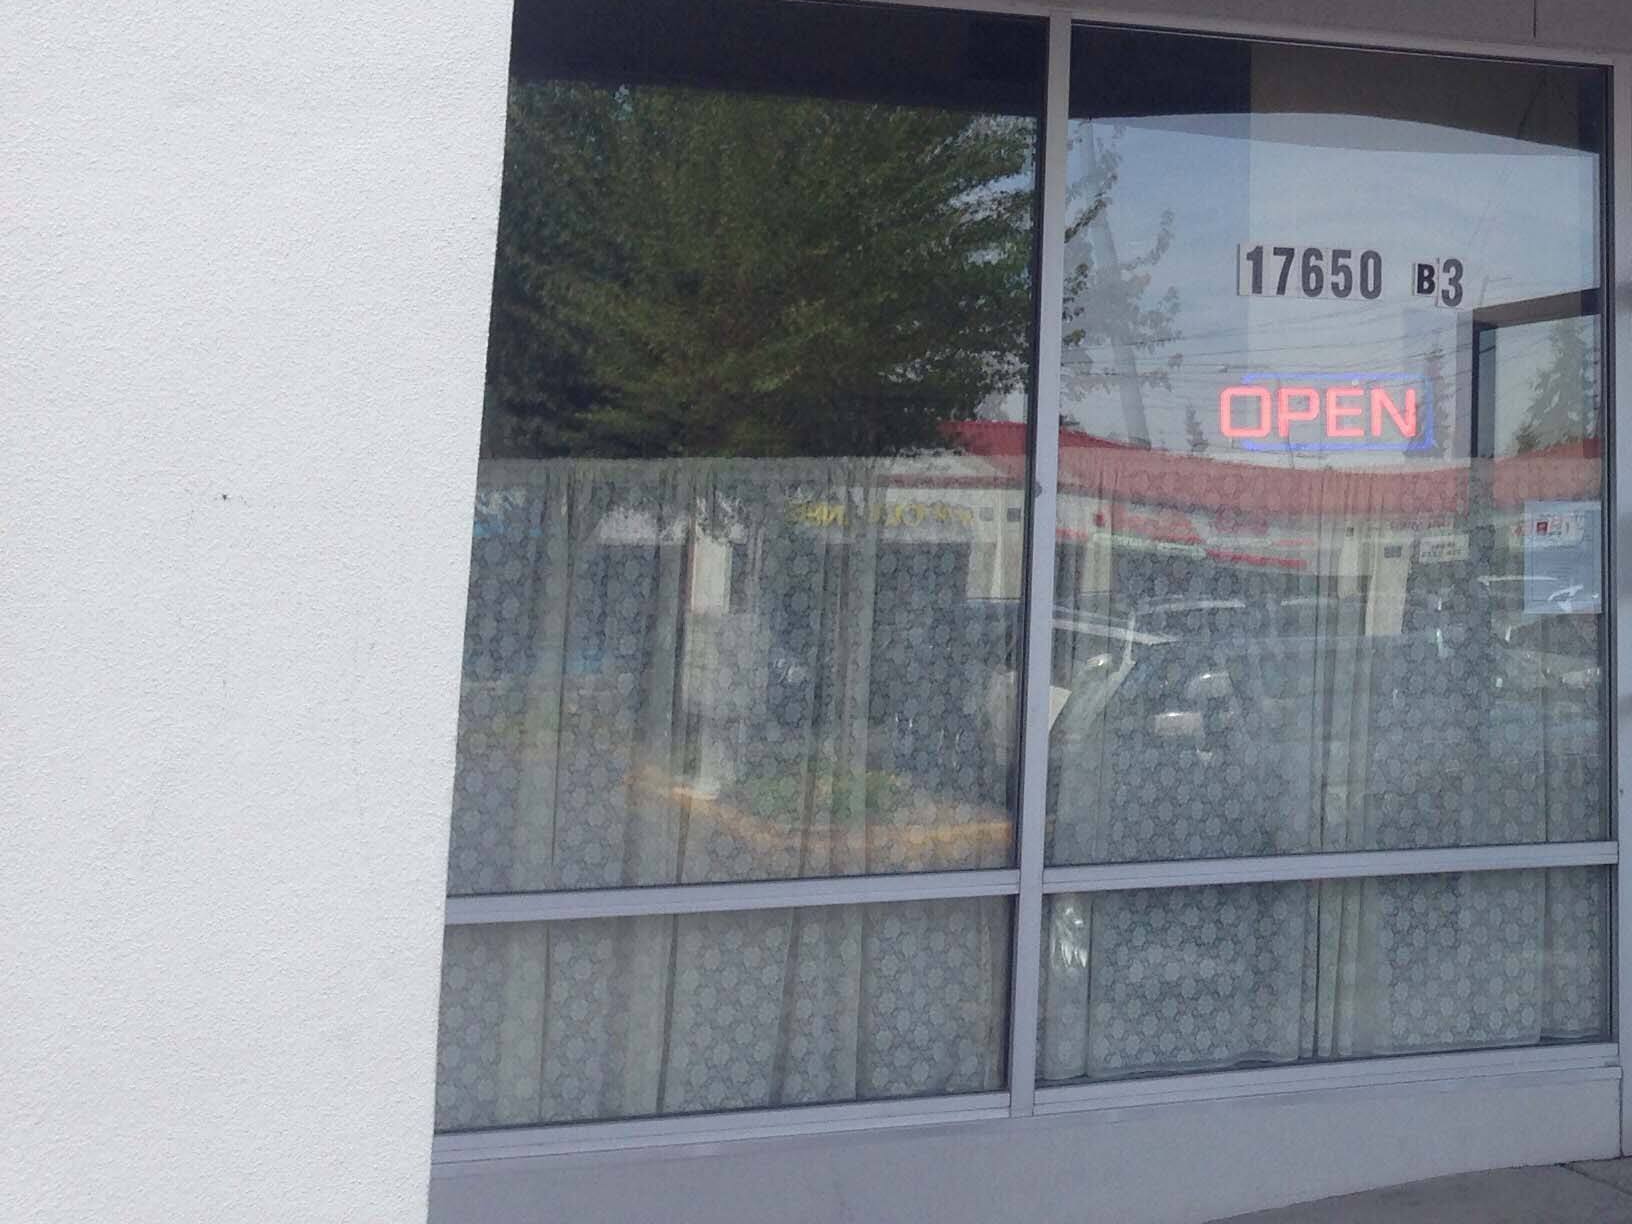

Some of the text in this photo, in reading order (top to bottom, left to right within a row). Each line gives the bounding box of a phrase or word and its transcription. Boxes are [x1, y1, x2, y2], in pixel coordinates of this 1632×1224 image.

[1245, 245, 1464, 307] 17650 B3
[1219, 385, 1418, 439] OPEN
